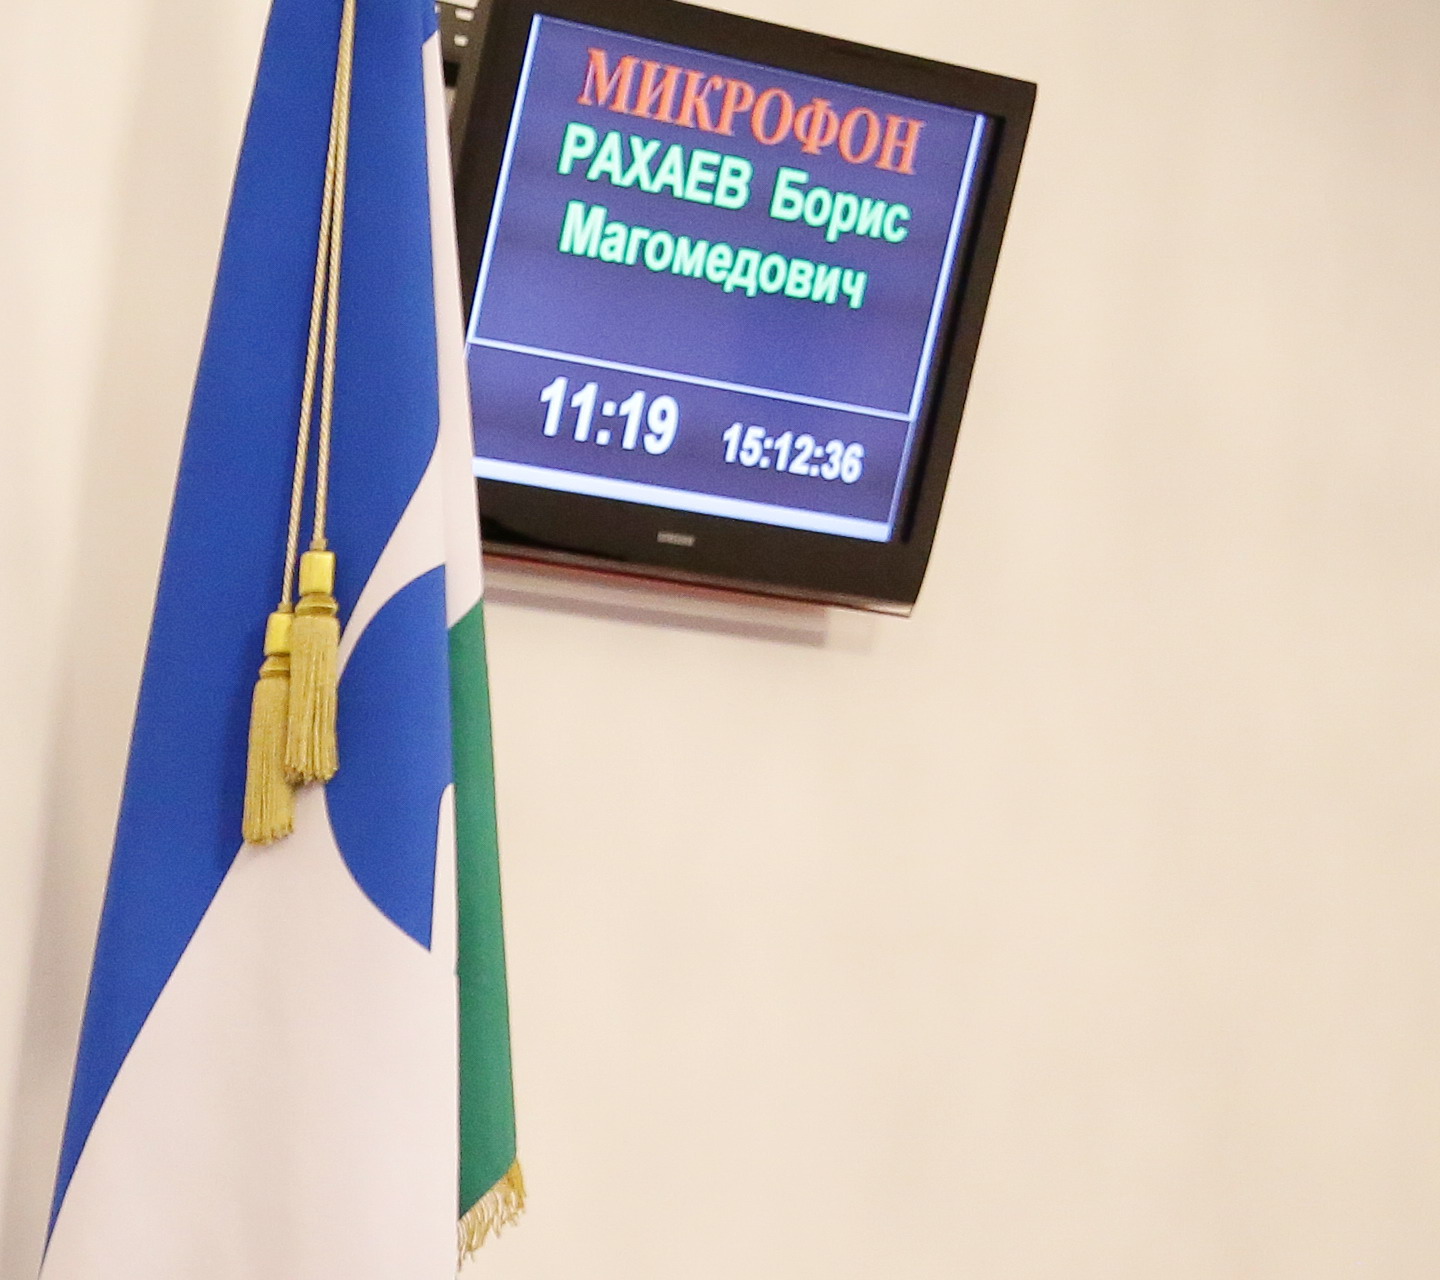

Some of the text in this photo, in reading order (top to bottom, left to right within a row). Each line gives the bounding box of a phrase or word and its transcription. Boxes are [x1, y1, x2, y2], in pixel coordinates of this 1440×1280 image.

[577, 46, 926, 175] МИКРОФОН
[556, 121, 912, 244] РАХАЕВ Борис
[558, 199, 869, 310] Магомедович
[539, 375, 865, 485] 11:19 15:12:36
